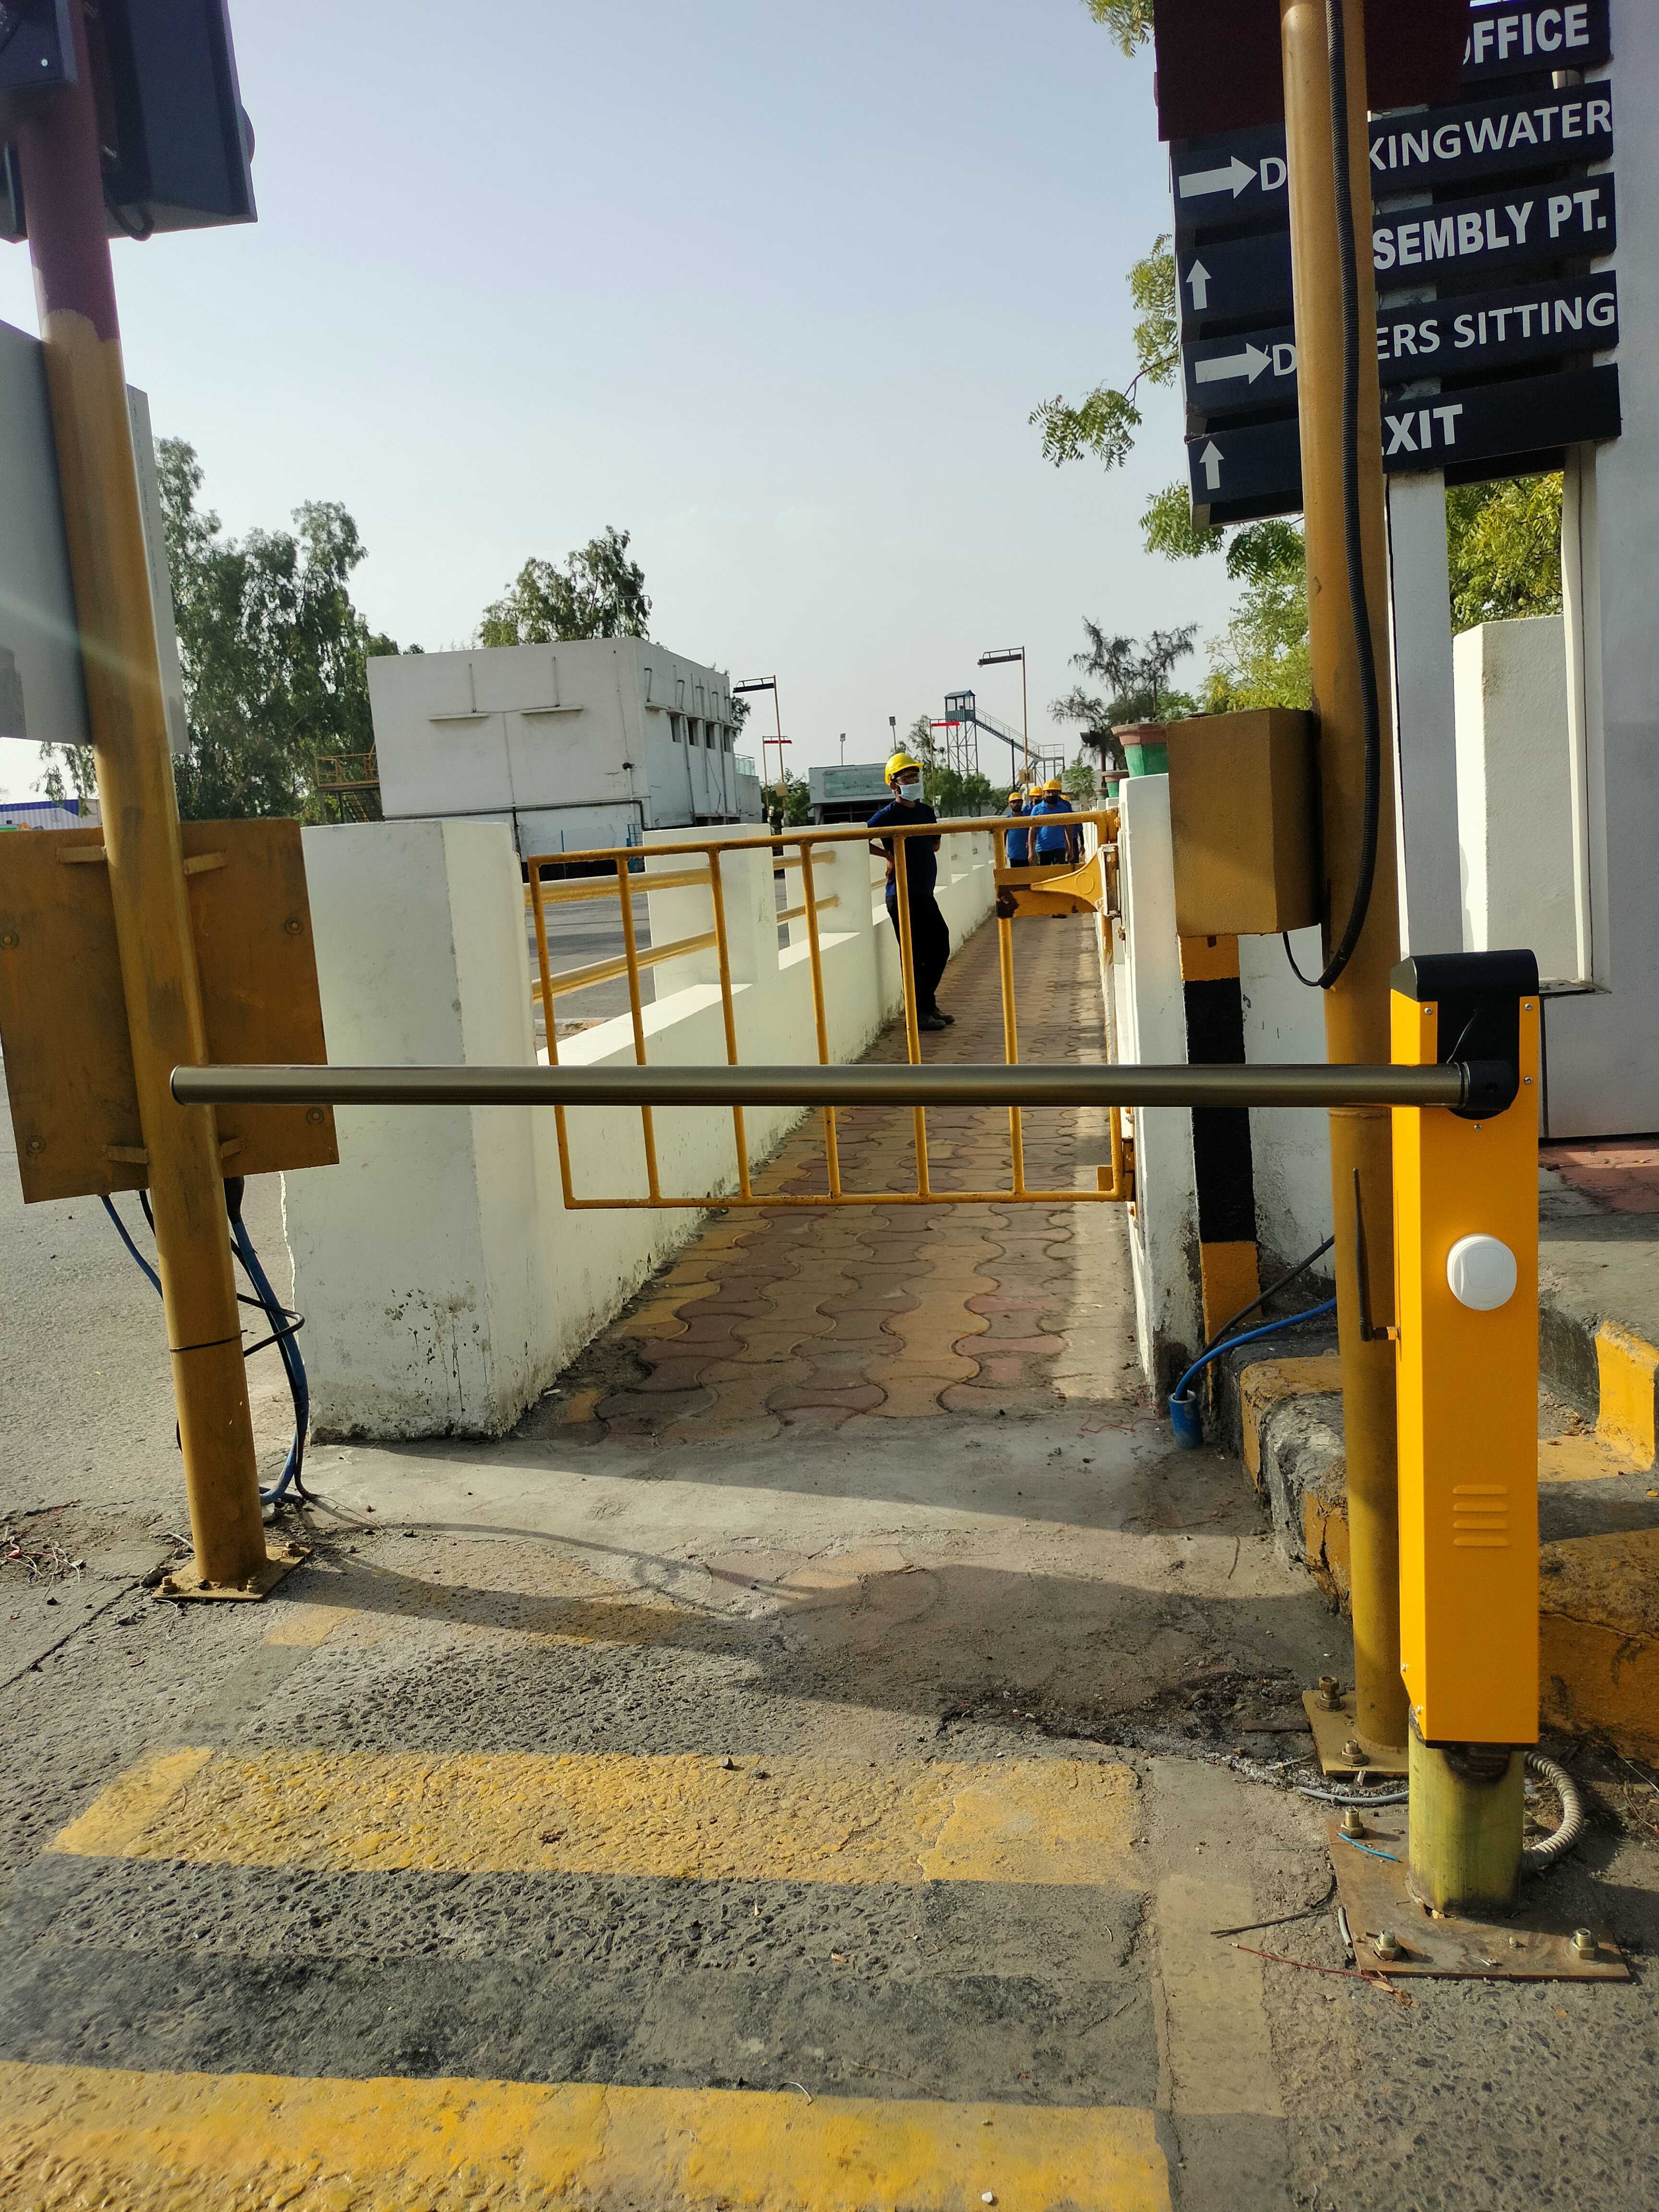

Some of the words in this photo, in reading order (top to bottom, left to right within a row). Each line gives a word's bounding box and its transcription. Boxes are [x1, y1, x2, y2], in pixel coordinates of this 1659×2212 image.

[1463, 3, 1589, 66] FFICE
[1260, 99, 1612, 191] DKINGWATER
[1372, 201, 1534, 270] SEMBLY
[1548, 189, 1607, 239] PT.
[1272, 319, 1441, 376] DERS
[1454, 292, 1615, 349] SITTING
[1381, 403, 1463, 456] XIT
